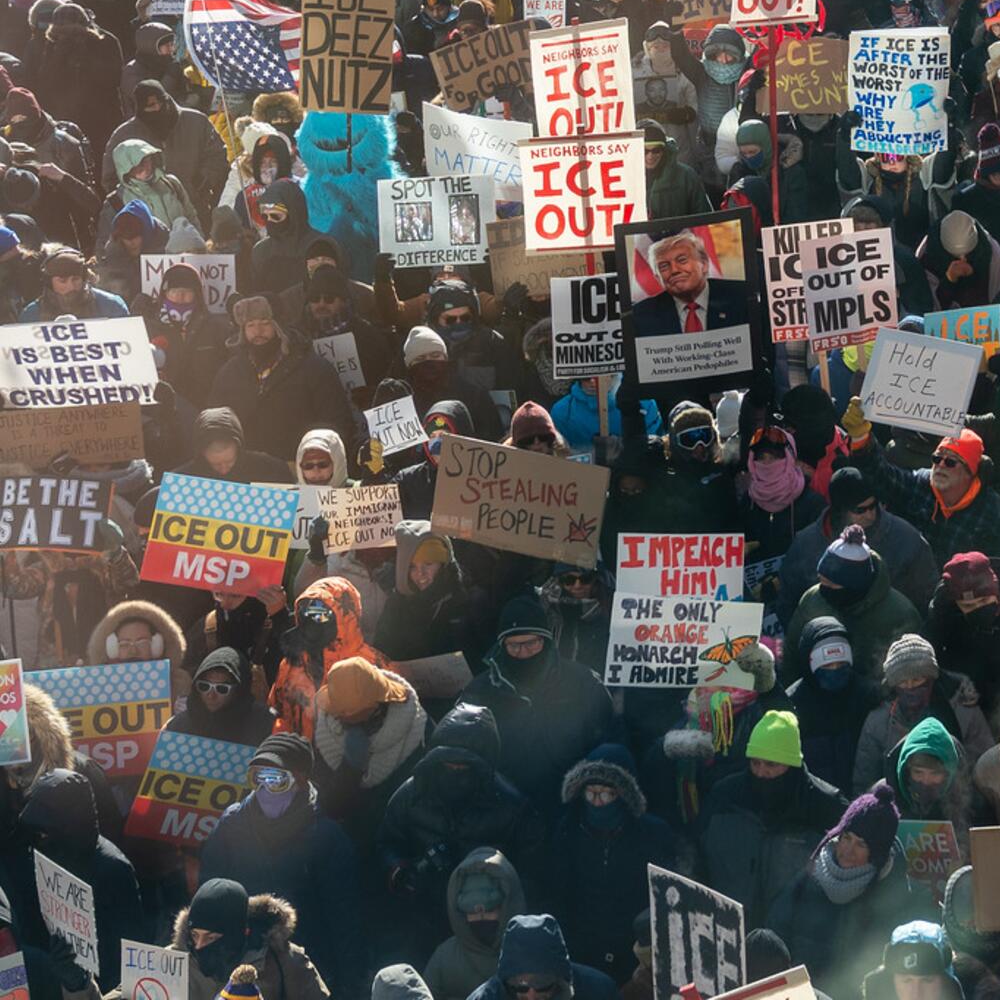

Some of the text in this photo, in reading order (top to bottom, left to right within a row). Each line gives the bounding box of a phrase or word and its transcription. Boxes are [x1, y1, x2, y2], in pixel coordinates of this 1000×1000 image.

[302, 11, 394, 61] DEEZ
[860, 37, 940, 51] IF ICE IS
[543, 43, 619, 63] NEIGHBORS SAY
[854, 49, 948, 65] AFTER THE
[545, 60, 618, 102] ICE
[852, 75, 902, 92] WORST
[853, 63, 950, 81] WORST OF THE
[302, 59, 393, 112] NUTZ
[856, 92, 897, 110] WHY
[549, 102, 625, 136] OUT!
[531, 143, 630, 159] NEIGHBORS SAY
[392, 176, 472, 200] SPOT THE
[533, 160, 626, 198] ICE
[534, 203, 635, 240] OUT!
[397, 250, 477, 266] DIFFERENCE
[817, 238, 880, 269] ICE
[808, 264, 890, 291] OUT OF
[814, 290, 891, 333] MPLS
[41, 323, 88, 342] ICE
[12, 342, 121, 364] IS BEST
[644, 336, 741, 355] Trump Still Polling Well
[889, 343, 937, 370] Hold
[651, 360, 738, 375] American Pedophiles
[653, 355, 673, 364] With
[27, 364, 122, 385] WHEN
[889, 372, 936, 396] ICE
[9, 386, 150, 406] CRUSHED!
[864, 392, 967, 425] ACCOUNTABLE
[445, 444, 507, 479] STOP
[4, 478, 99, 508] BE THE
[459, 478, 579, 507] STEALING
[0, 510, 101, 547] SALT
[477, 503, 555, 539] PEOPLE
[151, 513, 288, 558] ICE OUT
[620, 536, 744, 568] IMPEACH
[173, 552, 250, 586] MSP
[621, 599, 722, 622] THE ONLY
[634, 624, 709, 645] ORANGE
[614, 645, 698, 665] MONARCH
[608, 665, 699, 685] I ADMIRE
[126, 948, 184, 976] ICE OUT
